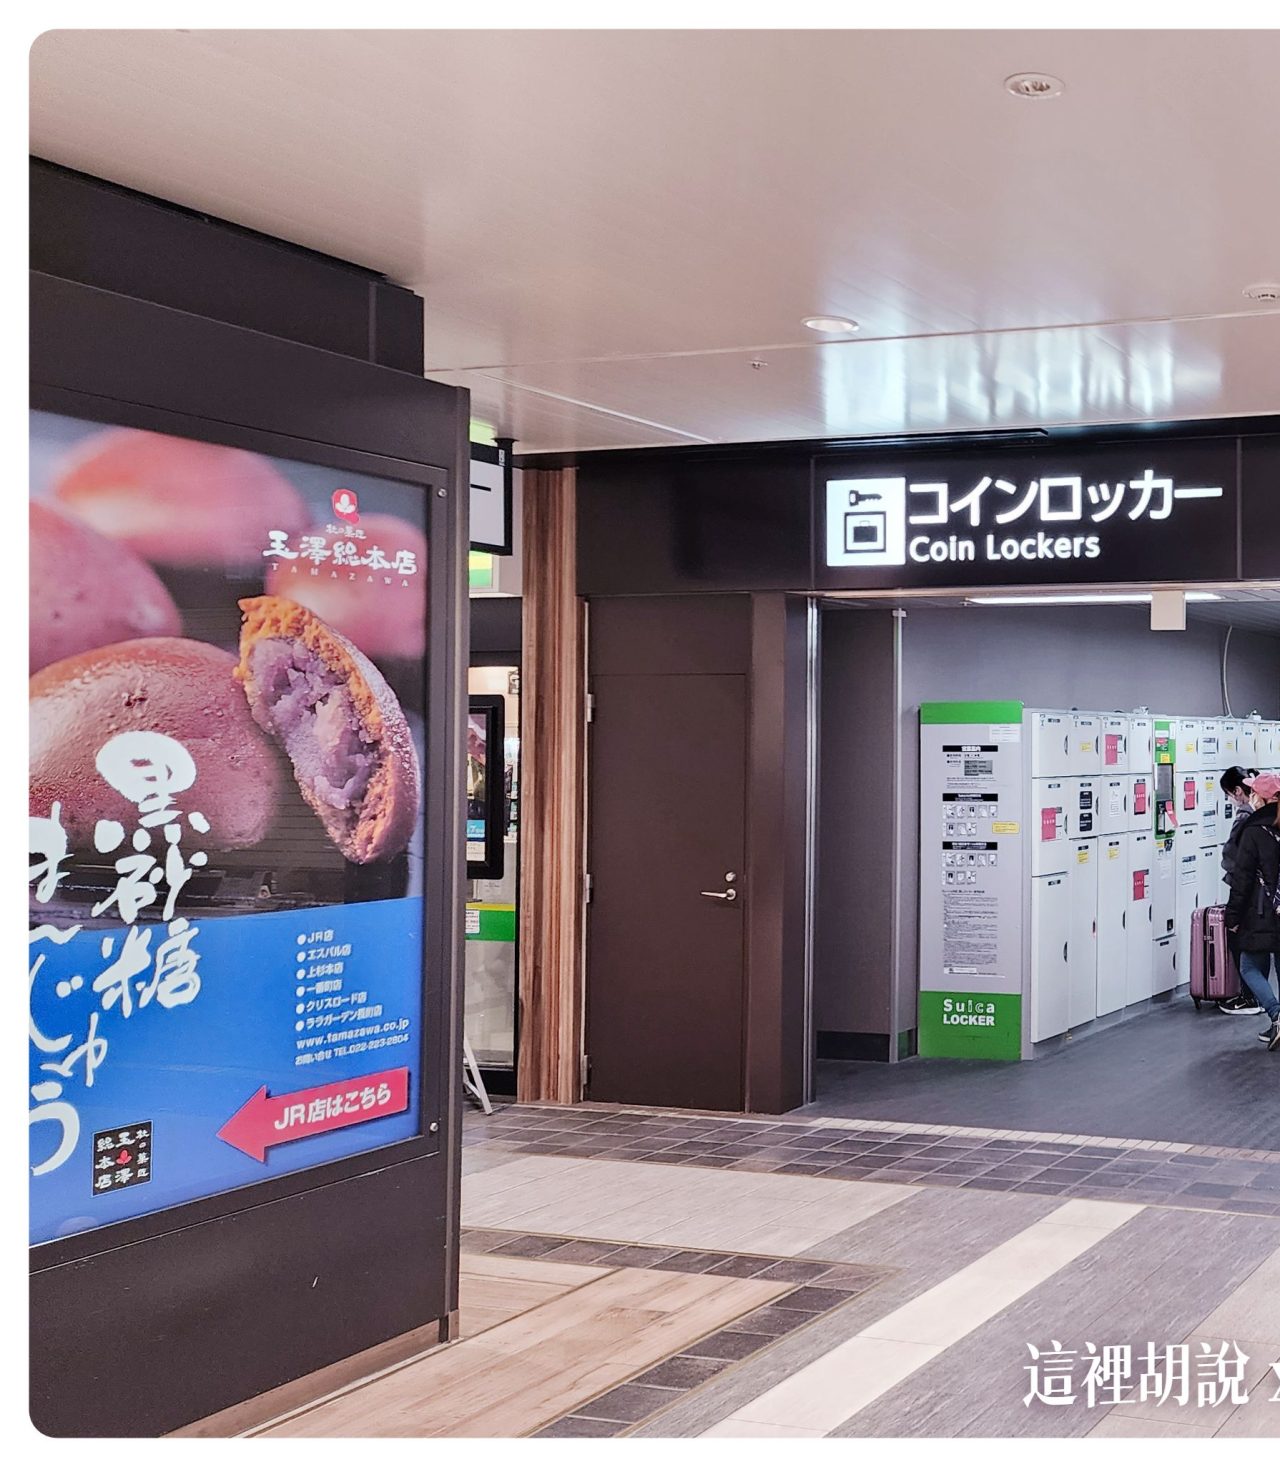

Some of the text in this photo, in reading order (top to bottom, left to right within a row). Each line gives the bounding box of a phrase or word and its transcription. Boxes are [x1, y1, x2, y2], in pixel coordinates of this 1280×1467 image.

[909, 469, 1223, 526] コインロッカー
[262, 530, 418, 575] 玉澤総本店
[909, 532, 1101, 562] Coin Lockers
[271, 562, 409, 587] TAMAZAWA
[92, 730, 211, 1018] 黒砂糖
[943, 999, 995, 1014] Suica
[943, 1014, 995, 1027] LOCKER
[296, 1018, 410, 1050] www.tamazawa.co.jp
[274, 1083, 391, 1130] JR店はこちら
